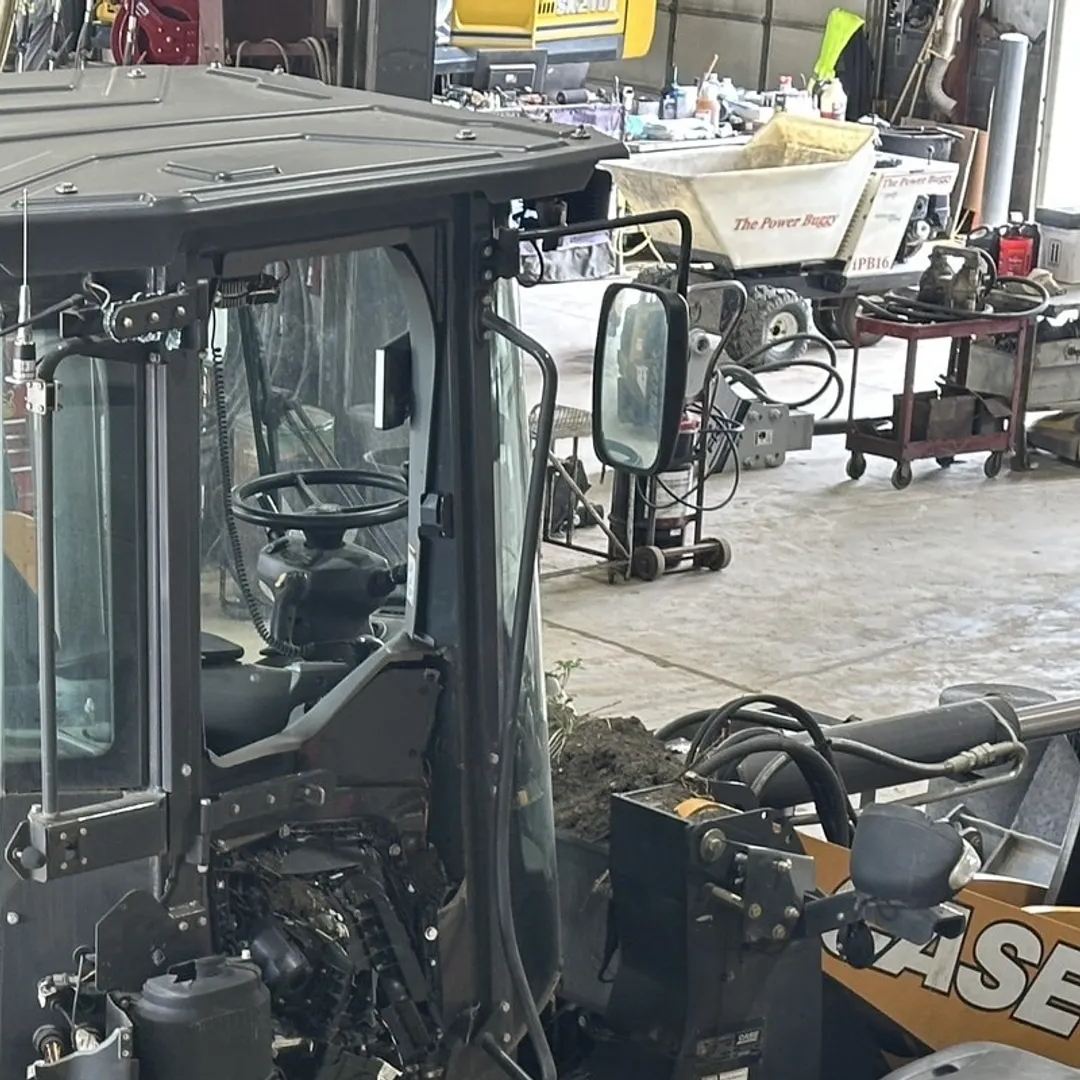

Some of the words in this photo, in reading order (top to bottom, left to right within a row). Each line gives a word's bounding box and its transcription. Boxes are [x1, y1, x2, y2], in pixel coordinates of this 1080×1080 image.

[733, 216, 759, 231] The
[760, 215, 801, 230] Power
[802, 213, 837, 229] Buggy
[820, 877, 1080, 1038] ASE
